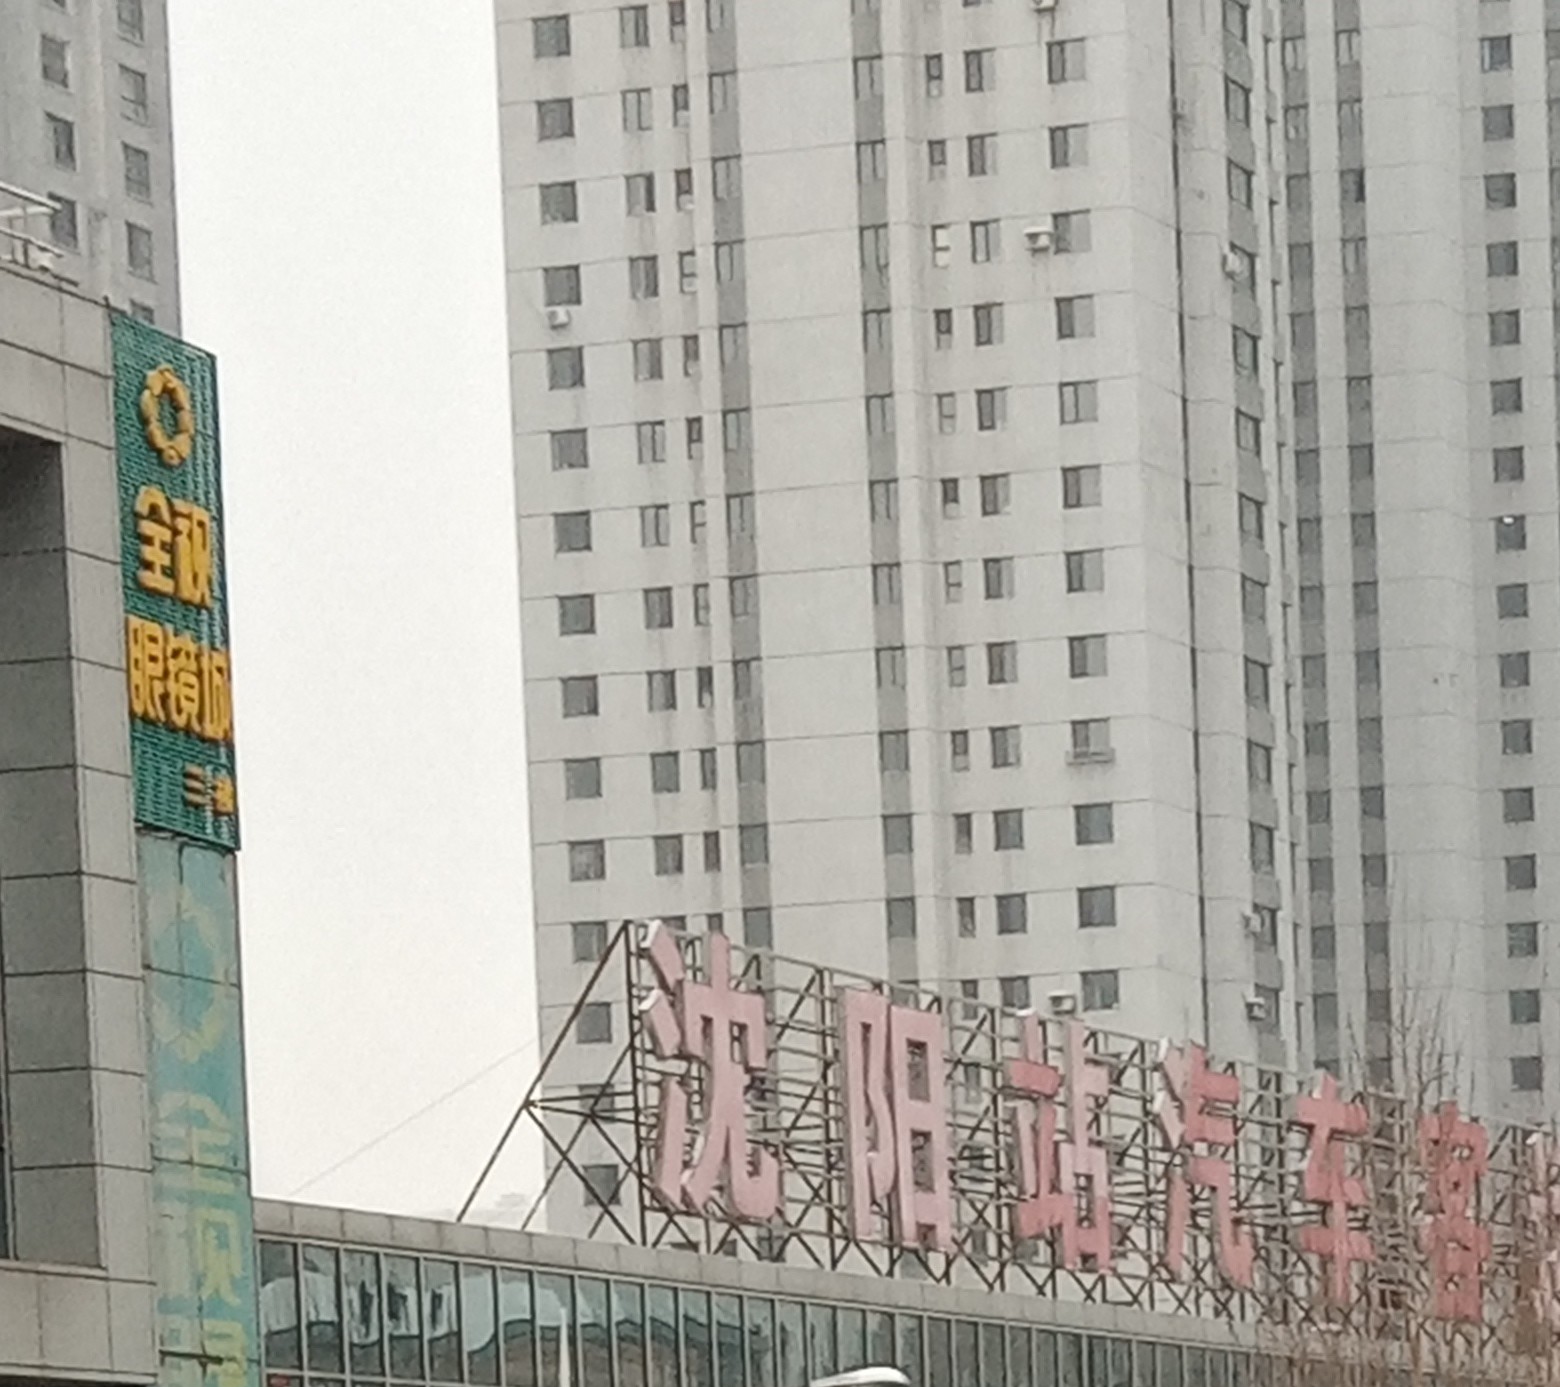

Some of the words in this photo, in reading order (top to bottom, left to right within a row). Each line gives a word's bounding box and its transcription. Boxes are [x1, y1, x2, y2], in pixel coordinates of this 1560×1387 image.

[135, 486, 212, 605] 全视
[128, 616, 233, 741] 眼镜城
